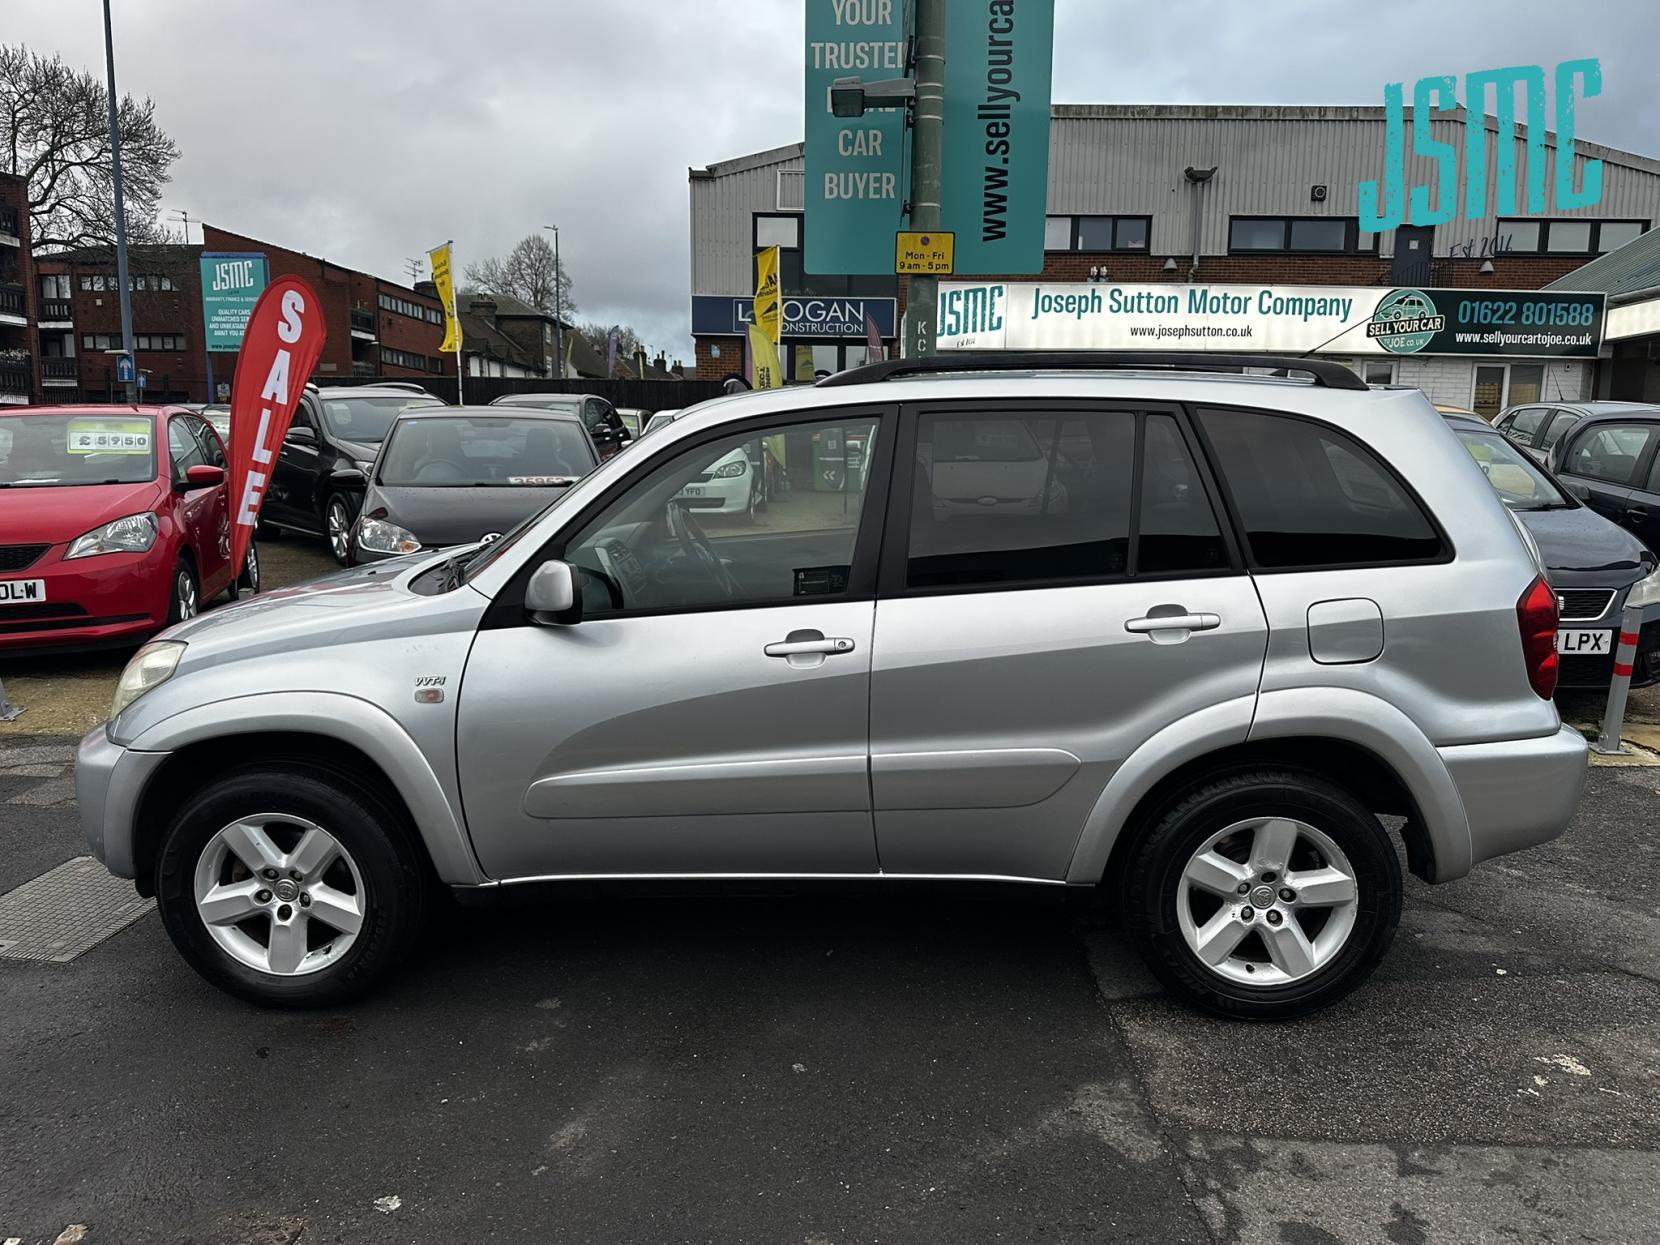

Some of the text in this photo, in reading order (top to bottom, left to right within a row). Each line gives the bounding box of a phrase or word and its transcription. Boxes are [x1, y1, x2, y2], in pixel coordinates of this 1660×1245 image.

[832, 0, 892, 25] YOUR
[838, 130, 882, 156] CAR
[824, 173, 896, 199] BUYER
[905, 252, 925, 260] Mon
[932, 252, 945, 260] Fri
[212, 260, 254, 291] JSMC
[782, 300, 864, 322] OGAN
[1031, 287, 1353, 323] Joseph Sutton Motor Company
[1458, 300, 1594, 327] 01622 801588
[781, 323, 863, 333] ONSTRUCTION
[1129, 323, 1253, 340] www.josephsutton.co.uk
[1369, 318, 1441, 336] SELL YOUR CAR
[1388, 336, 1406, 349] JOE
[1455, 330, 1593, 348] www.sellyourcartojoe.co.uk
[236, 289, 305, 526] SALE
[1564, 633, 1604, 651] LPX
